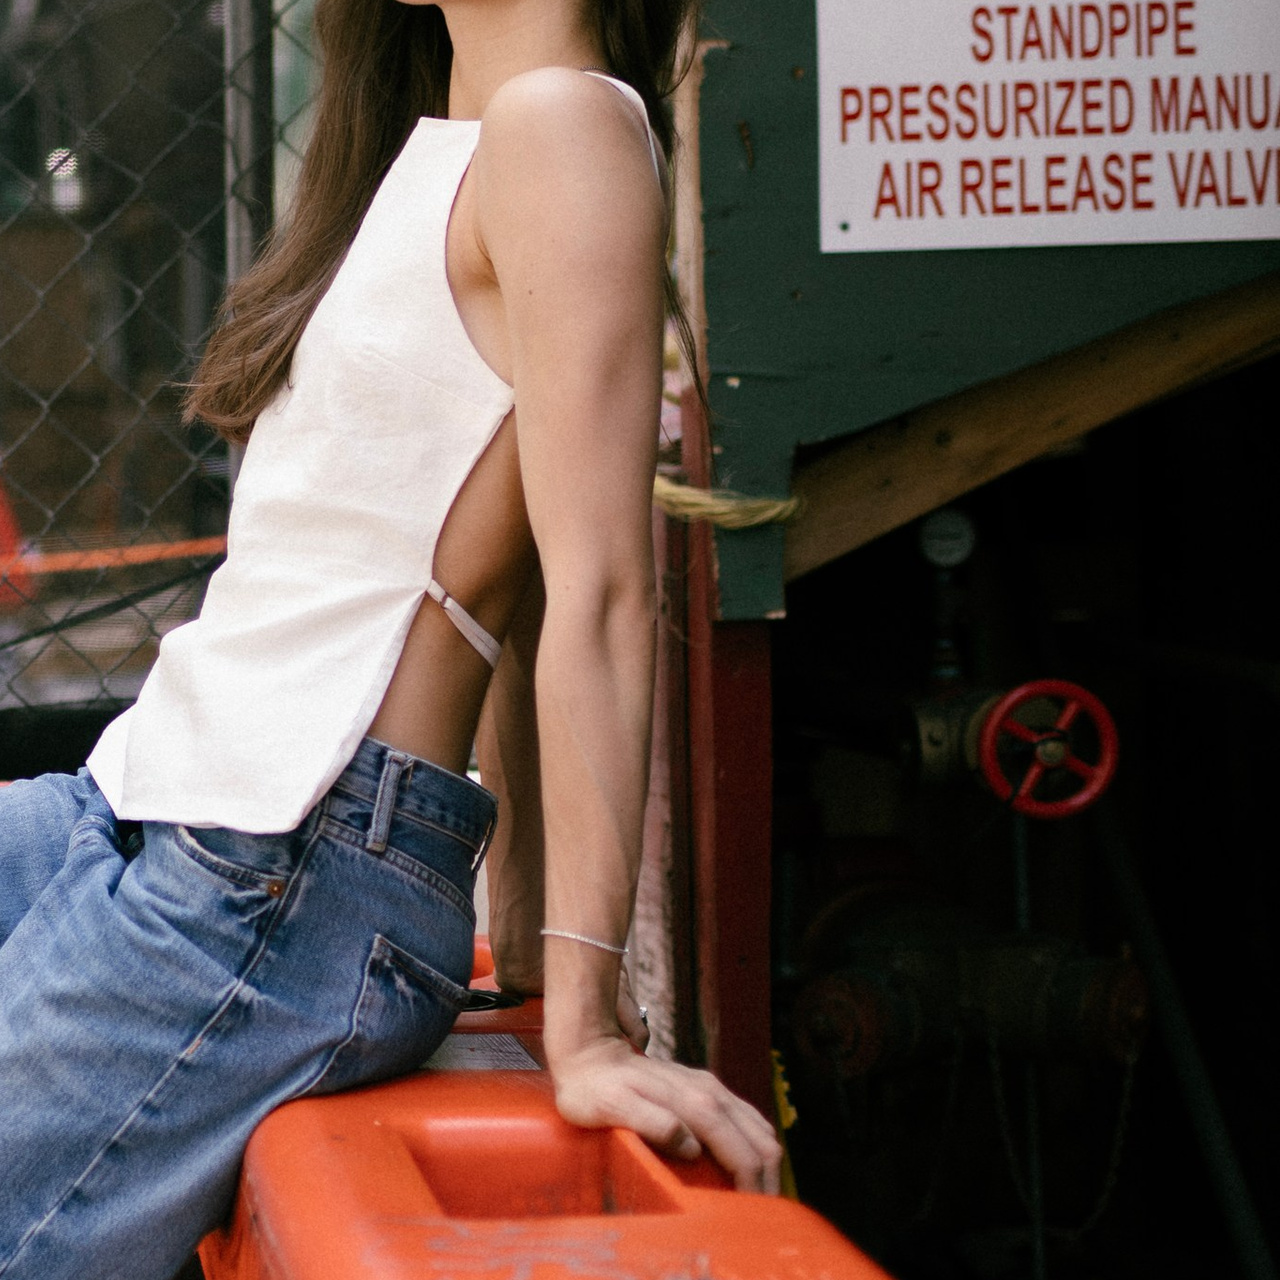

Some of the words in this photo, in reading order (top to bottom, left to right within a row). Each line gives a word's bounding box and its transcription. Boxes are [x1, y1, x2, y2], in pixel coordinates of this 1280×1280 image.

[970, 0, 1197, 63] STANDPIPE
[840, 77, 1134, 144] PRESSURIZED
[1150, 73, 1280, 135] MANU
[873, 160, 944, 219] AIR
[960, 152, 1154, 216] RELEASE
[1168, 147, 1280, 208] VALV
